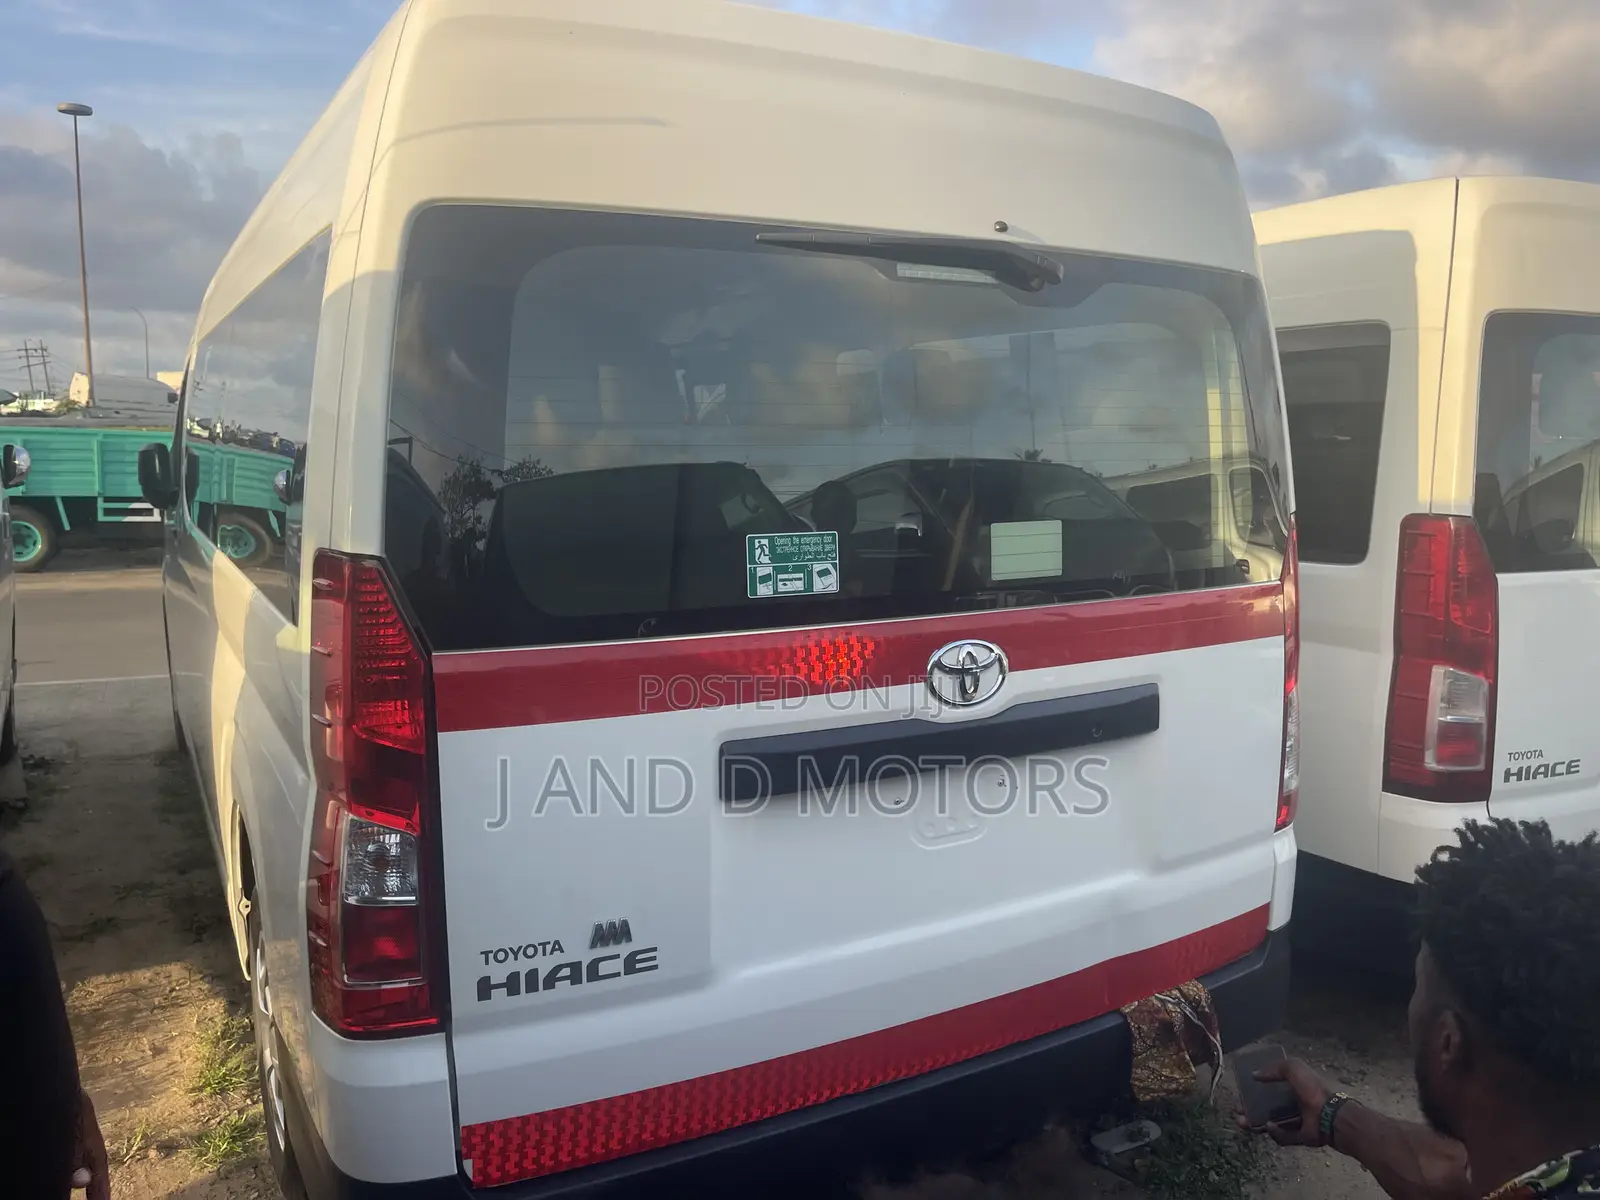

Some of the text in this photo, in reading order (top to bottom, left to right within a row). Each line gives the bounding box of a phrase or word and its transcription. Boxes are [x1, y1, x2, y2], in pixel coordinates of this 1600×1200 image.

[774, 534, 833, 547] Opening the emergency door
[1507, 749, 1544, 762] TOYOTA
[1503, 759, 1581, 784] HIACE
[480, 939, 565, 966] TOYOTA
[476, 946, 659, 1002] HIACE
